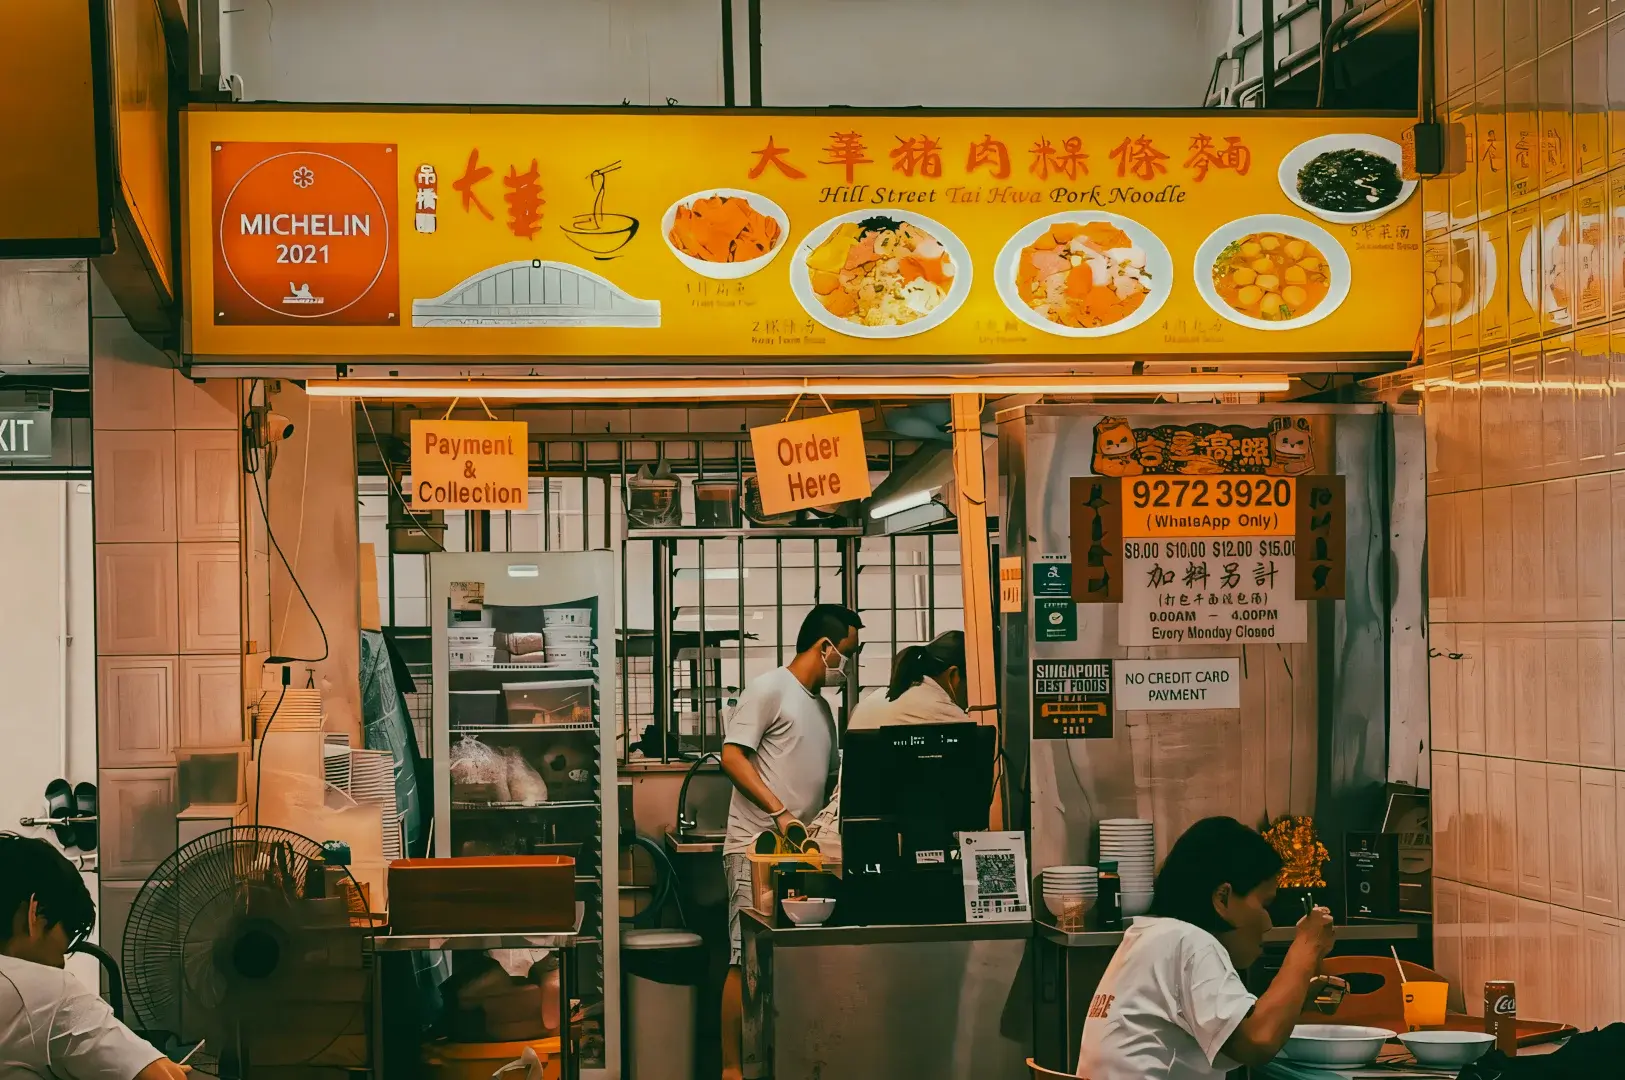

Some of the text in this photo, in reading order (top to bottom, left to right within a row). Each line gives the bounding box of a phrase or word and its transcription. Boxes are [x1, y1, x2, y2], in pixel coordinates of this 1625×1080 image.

[819, 185, 1186, 206] Hill Street Tai Hwa Pork Noodle
[240, 213, 371, 237] MICHELIN
[276, 244, 330, 264] 2021
[425, 432, 514, 461] Payment
[777, 433, 840, 467] Order
[463, 460, 477, 479] &
[419, 481, 522, 504] Collection
[787, 472, 841, 502] Here
[1132, 479, 1291, 509] 9272 3920
[1124, 542, 1159, 559] $8.00
[1166, 541, 1206, 559] $10.00
[1212, 540, 1252, 557] $12.00
[1146, 560, 1279, 590] 加料另計
[1187, 626, 1232, 641] Monday
[1036, 664, 1110, 678] SINGAPORE
[1125, 671, 1230, 685] NO CREDIT CARD
[1038, 679, 1107, 693] BEST FOODS
[1148, 688, 1207, 701] PAYMENT
